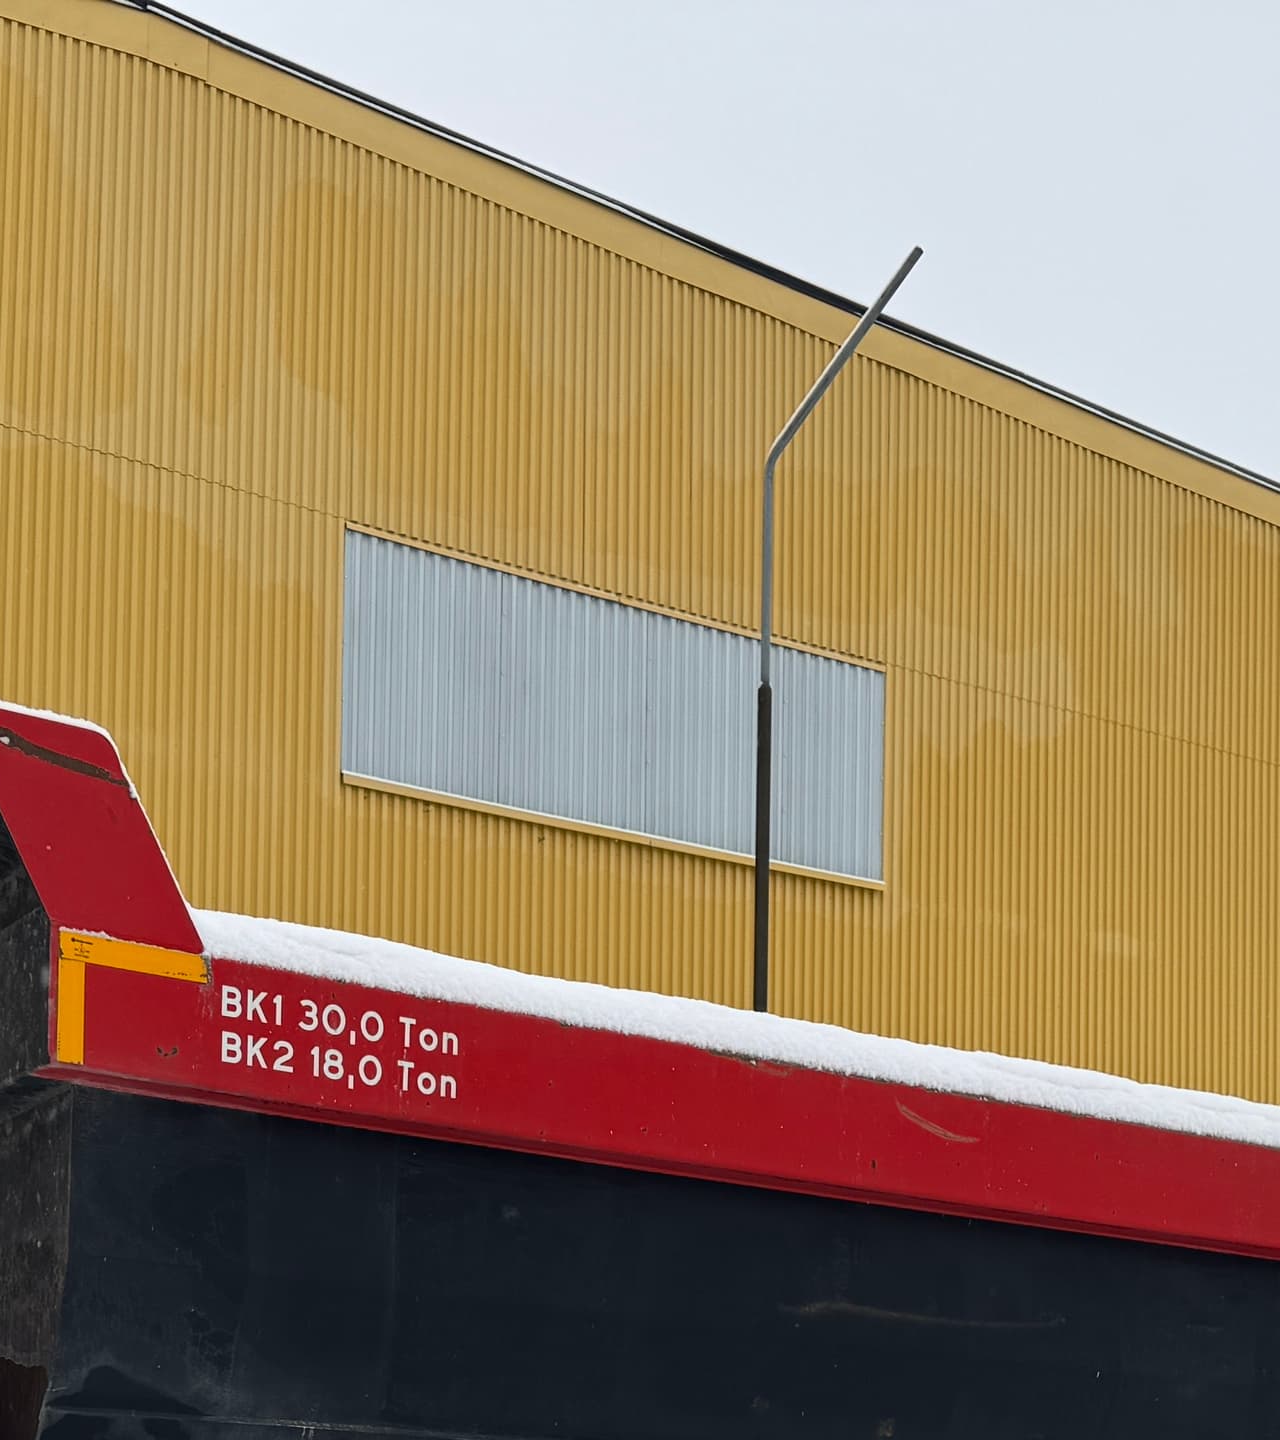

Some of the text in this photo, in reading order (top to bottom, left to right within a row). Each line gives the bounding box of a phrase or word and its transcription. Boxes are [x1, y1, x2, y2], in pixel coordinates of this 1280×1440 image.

[221, 984, 459, 1056] BK1 30,0 Ton
[221, 1030, 457, 1099] BK2 18,0 Ton
